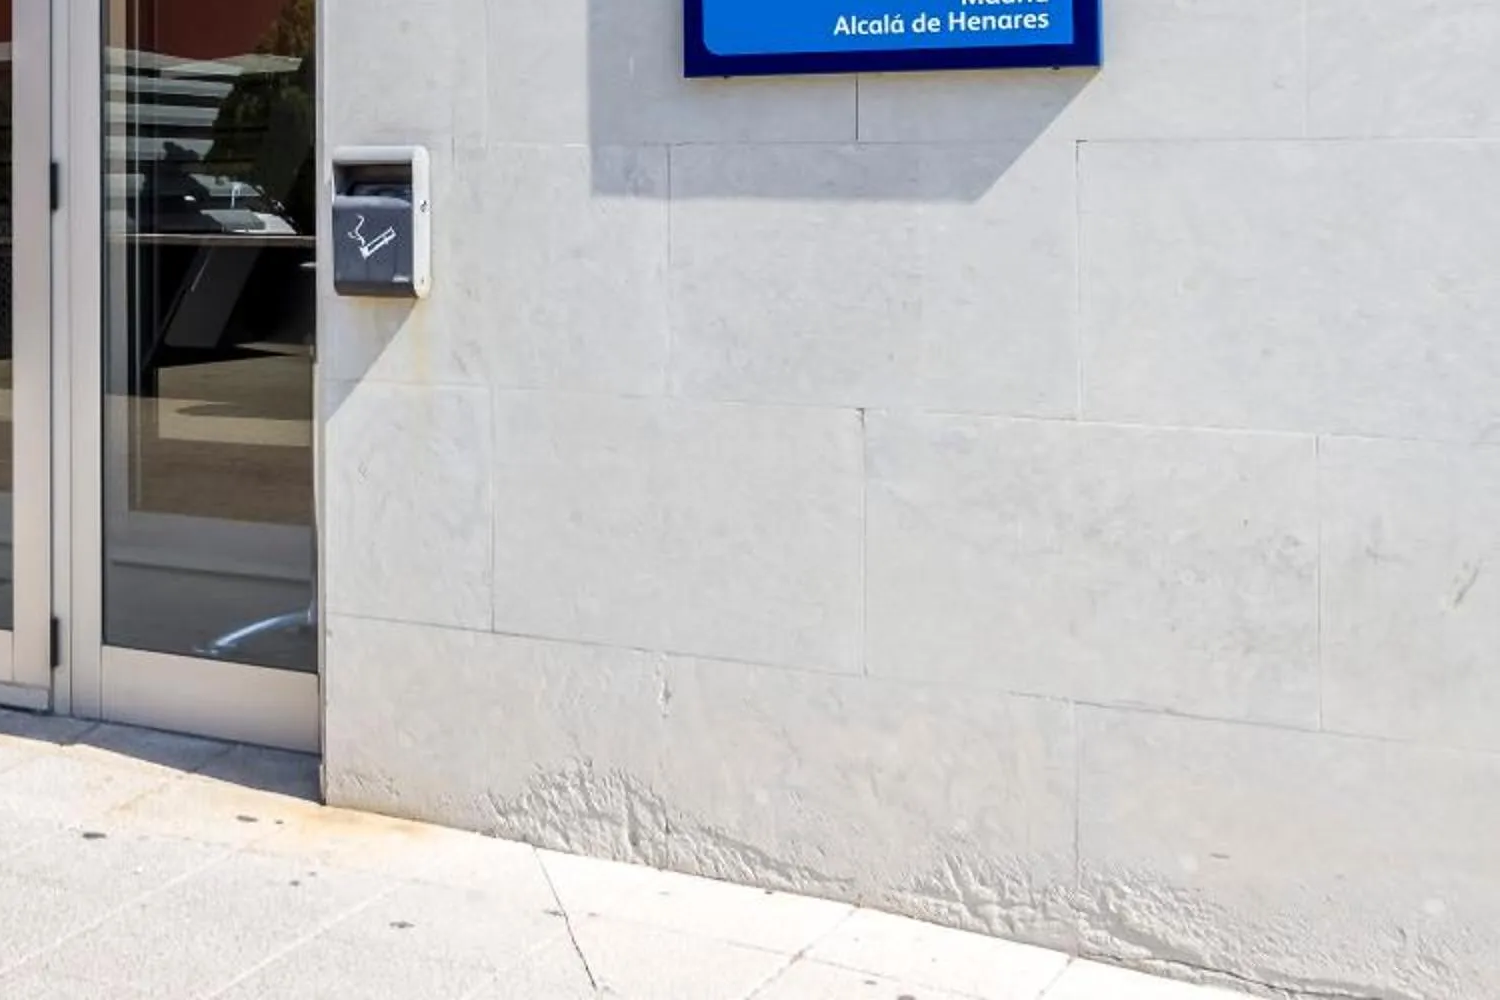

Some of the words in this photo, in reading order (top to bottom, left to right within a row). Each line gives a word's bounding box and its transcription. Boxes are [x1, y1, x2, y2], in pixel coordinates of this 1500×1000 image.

[833, 13, 904, 36] Alcalá
[912, 12, 941, 33] de
[949, 11, 1049, 32] Henares
